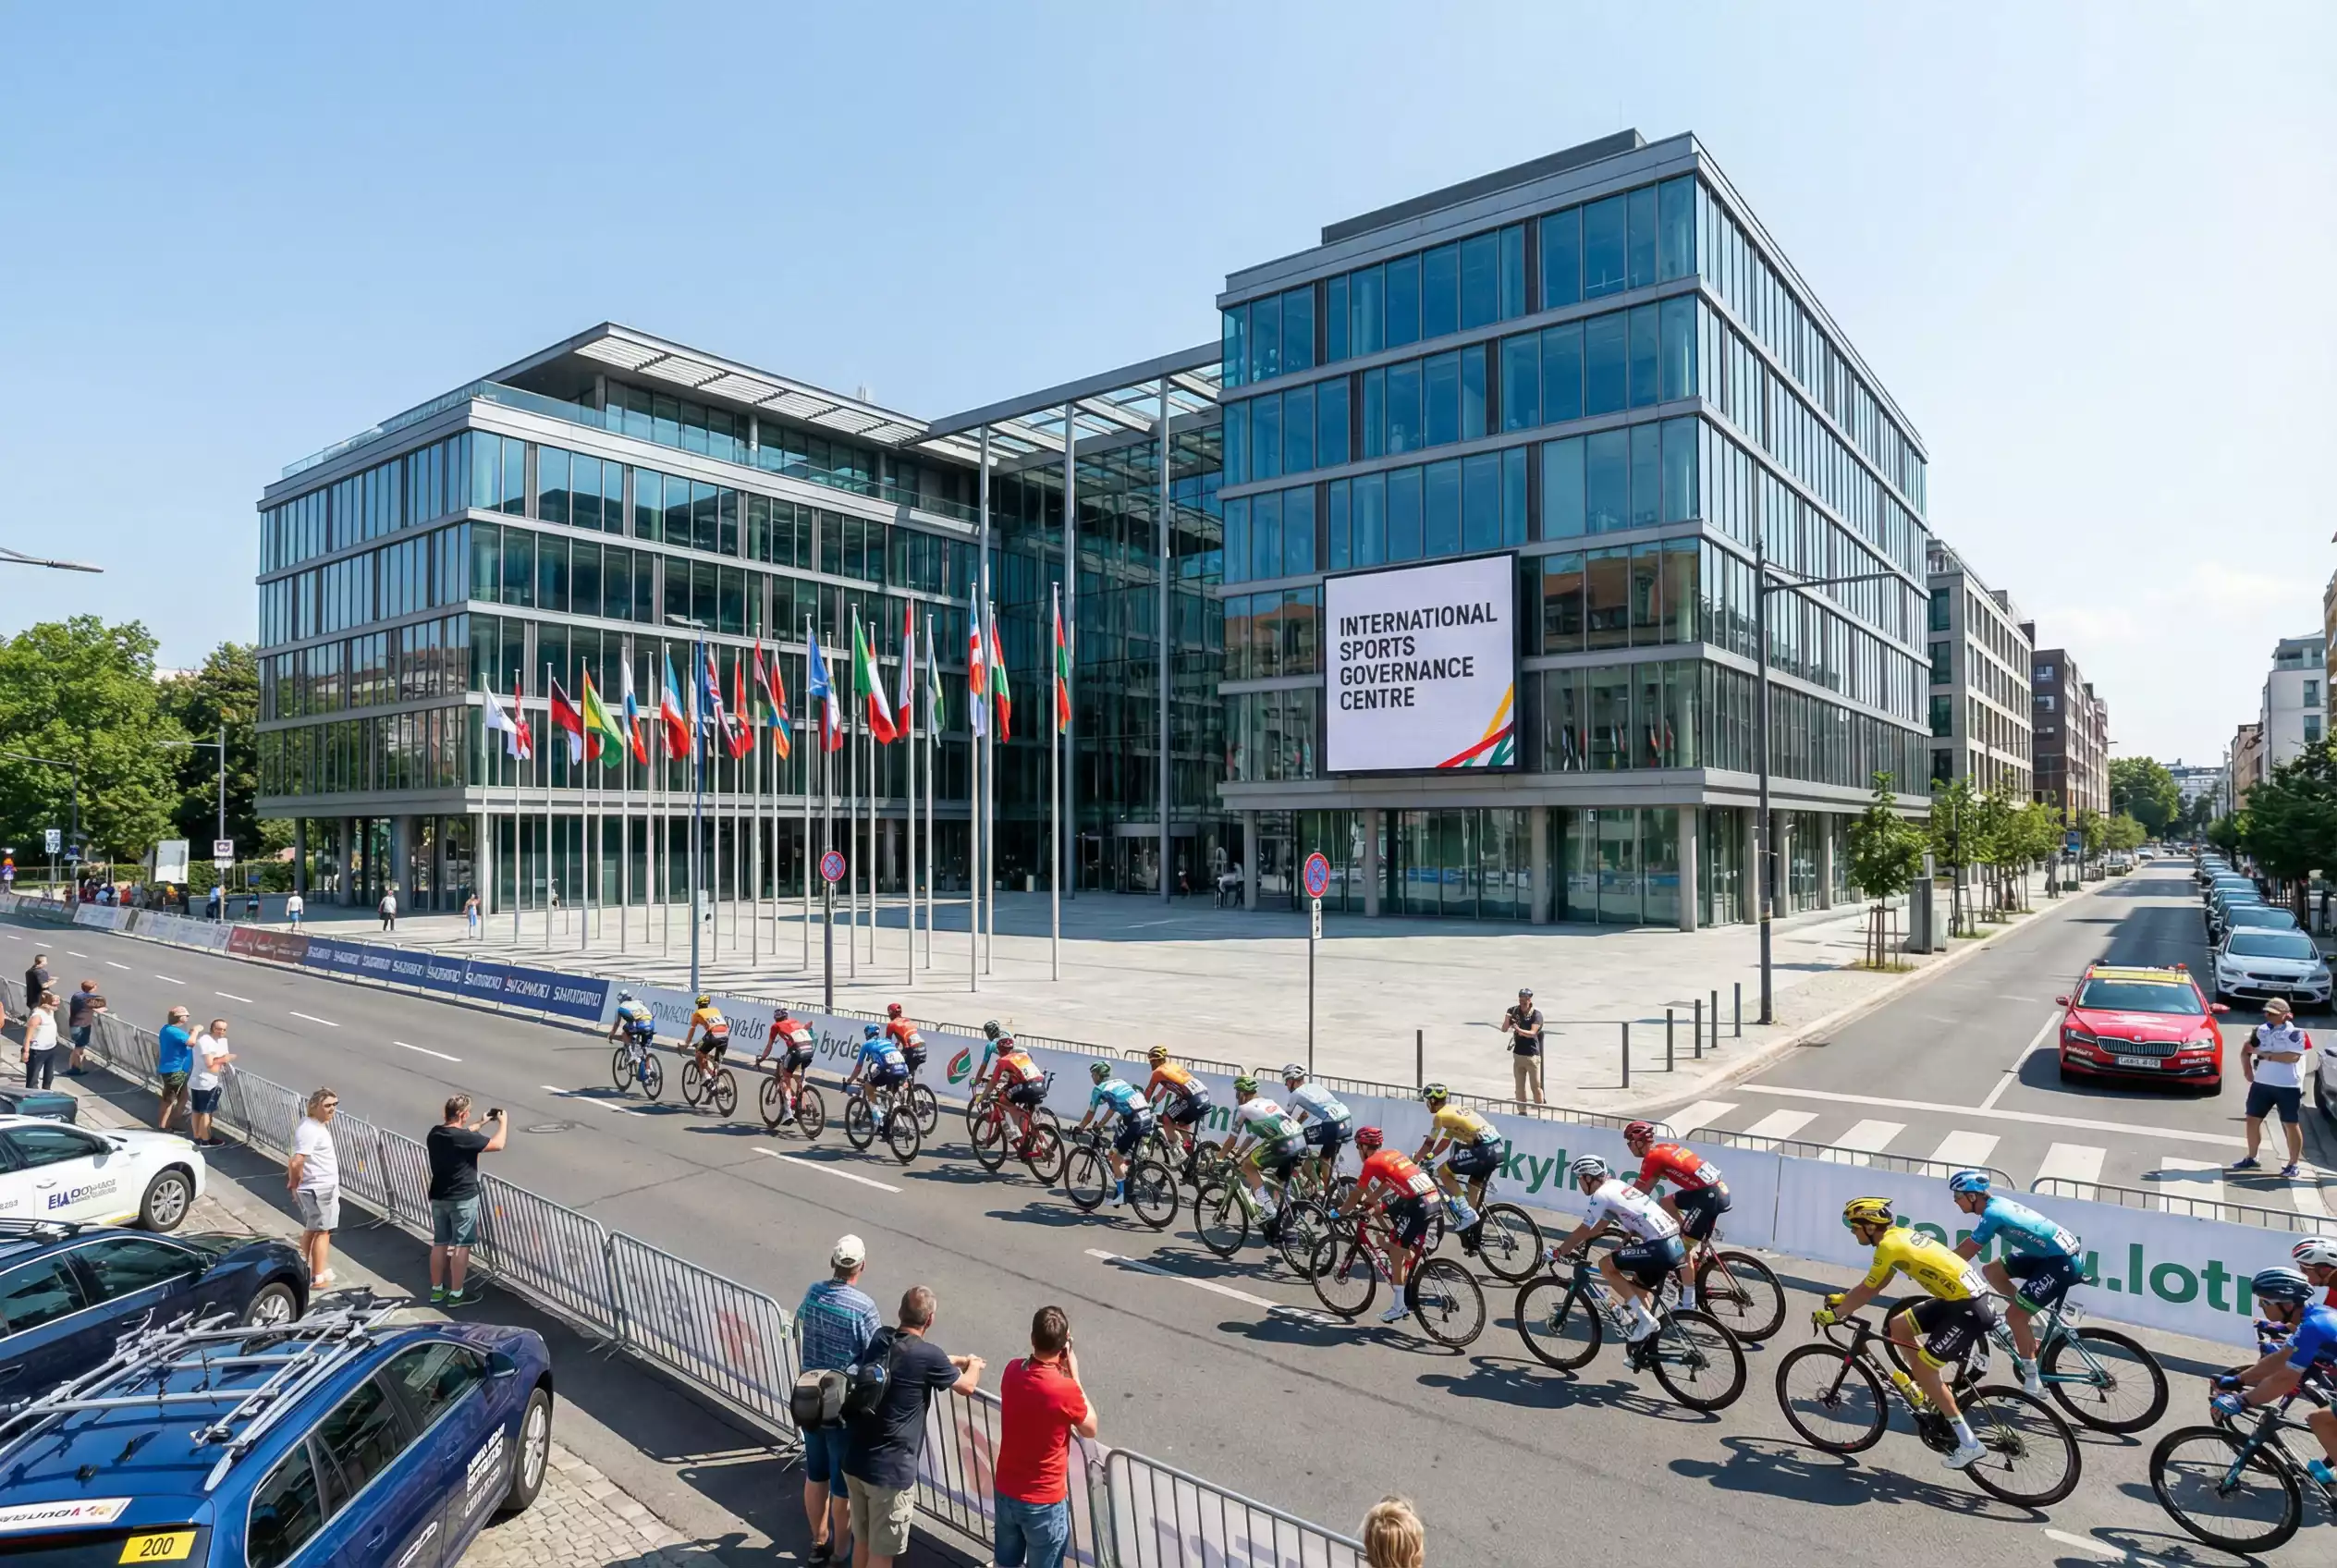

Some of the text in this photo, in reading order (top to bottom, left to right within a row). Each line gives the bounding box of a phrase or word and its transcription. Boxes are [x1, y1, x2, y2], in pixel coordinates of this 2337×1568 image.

[1340, 602, 1499, 637] INTERNATIONAL
[1340, 636, 1415, 662] SPORTS
[1340, 656, 1474, 686] GOVERNANCE
[1340, 687, 1415, 711] CENTRE
[140, 1537, 175, 1558] 200
